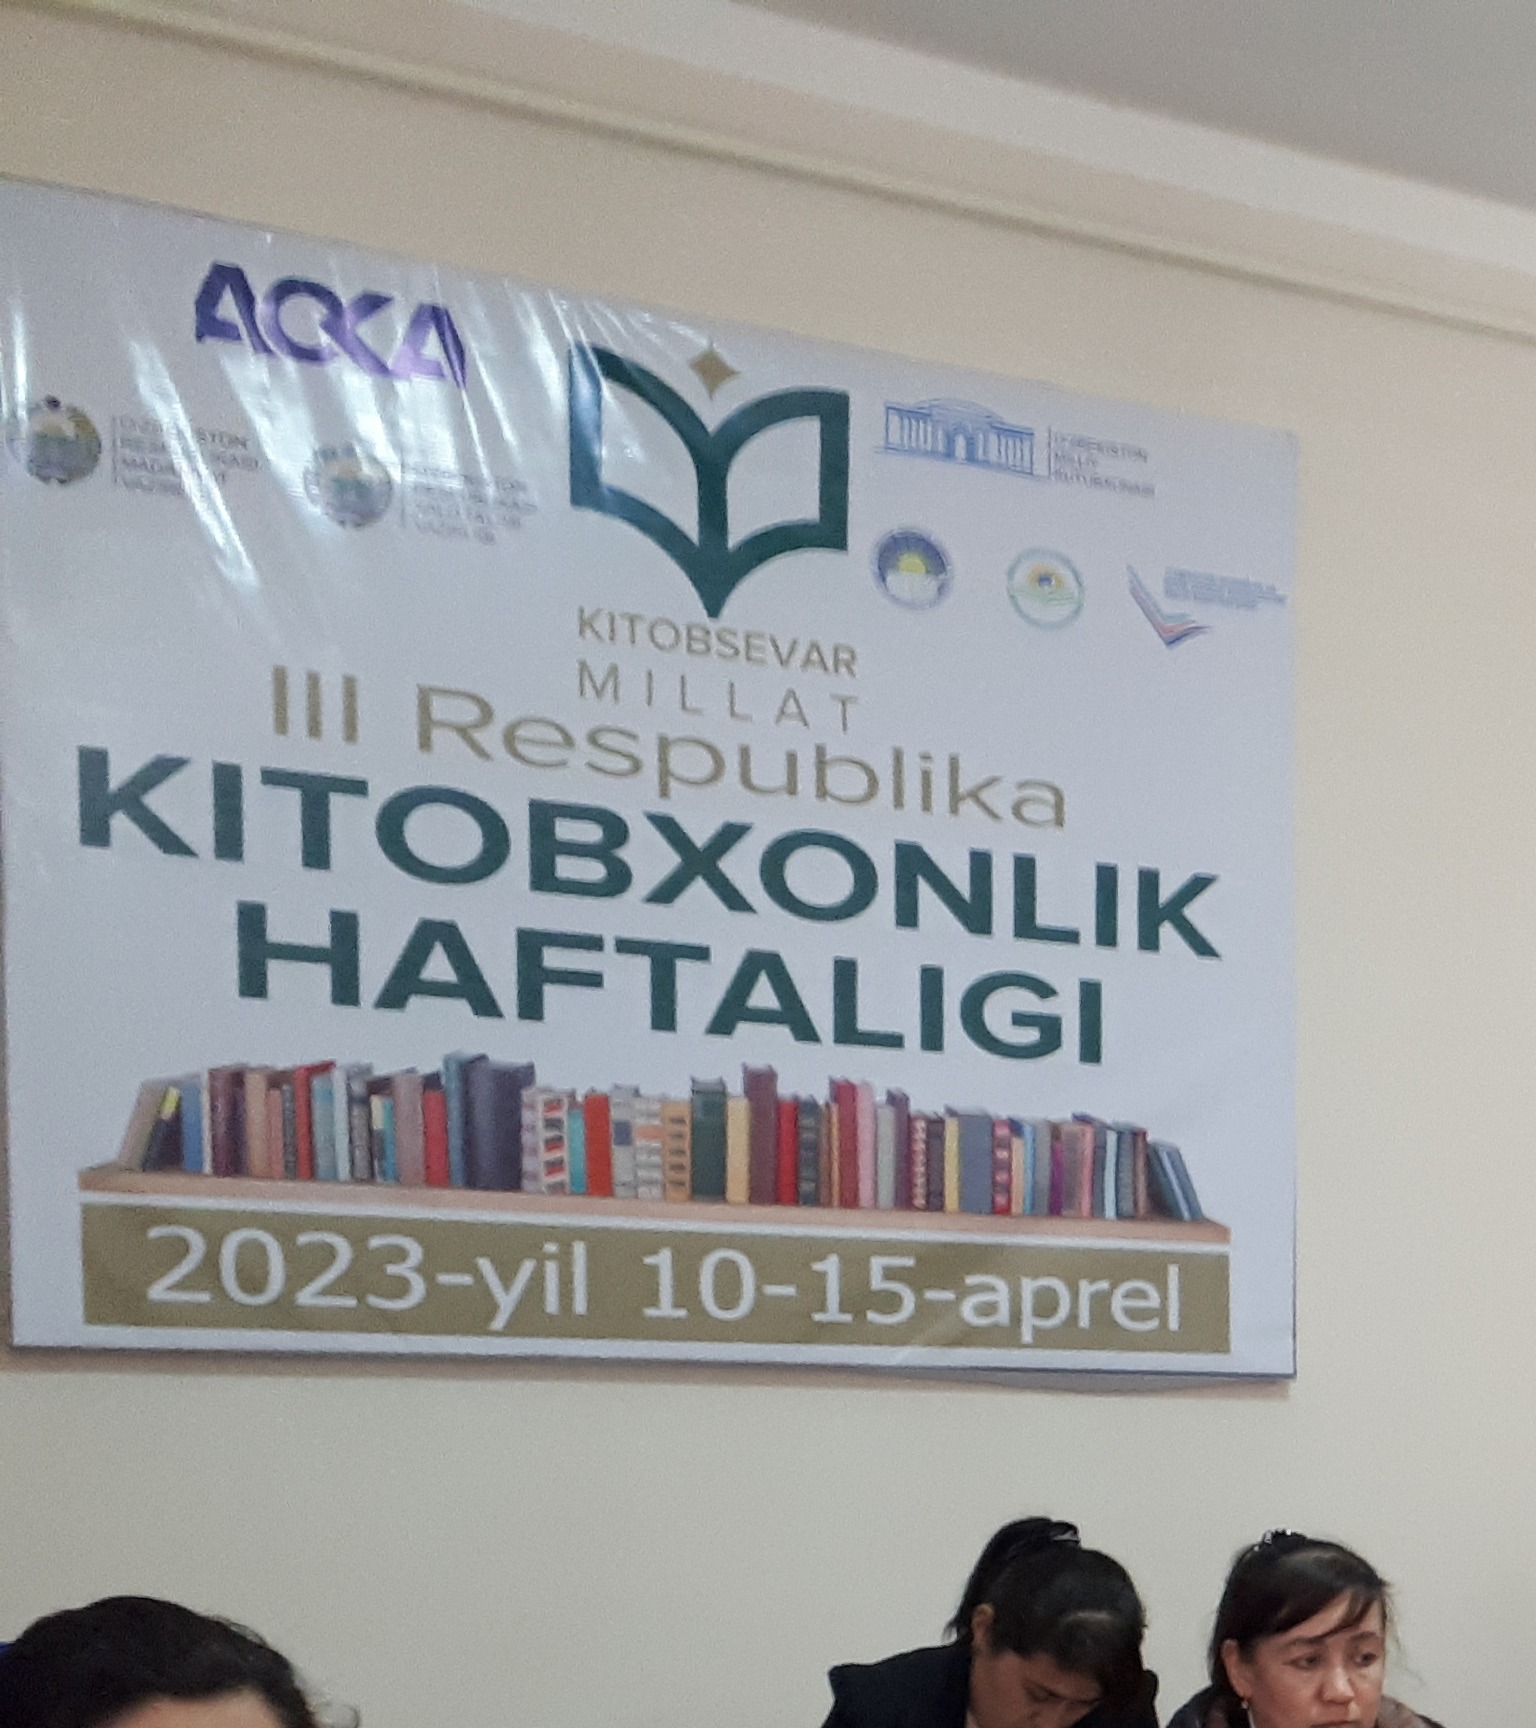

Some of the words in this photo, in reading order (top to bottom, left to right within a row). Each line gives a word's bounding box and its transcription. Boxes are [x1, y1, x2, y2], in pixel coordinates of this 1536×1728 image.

[577, 658, 858, 732] MILLAT
[579, 605, 857, 678] KITOBSEVAR
[272, 665, 358, 745] III
[417, 683, 1066, 829] Respublika
[78, 745, 1222, 958] KITOBXONLIK
[236, 901, 1103, 1063] HAFTALIGI
[146, 1225, 588, 1330] 2023-yil
[641, 1248, 1181, 1341] 10-15-aprel
